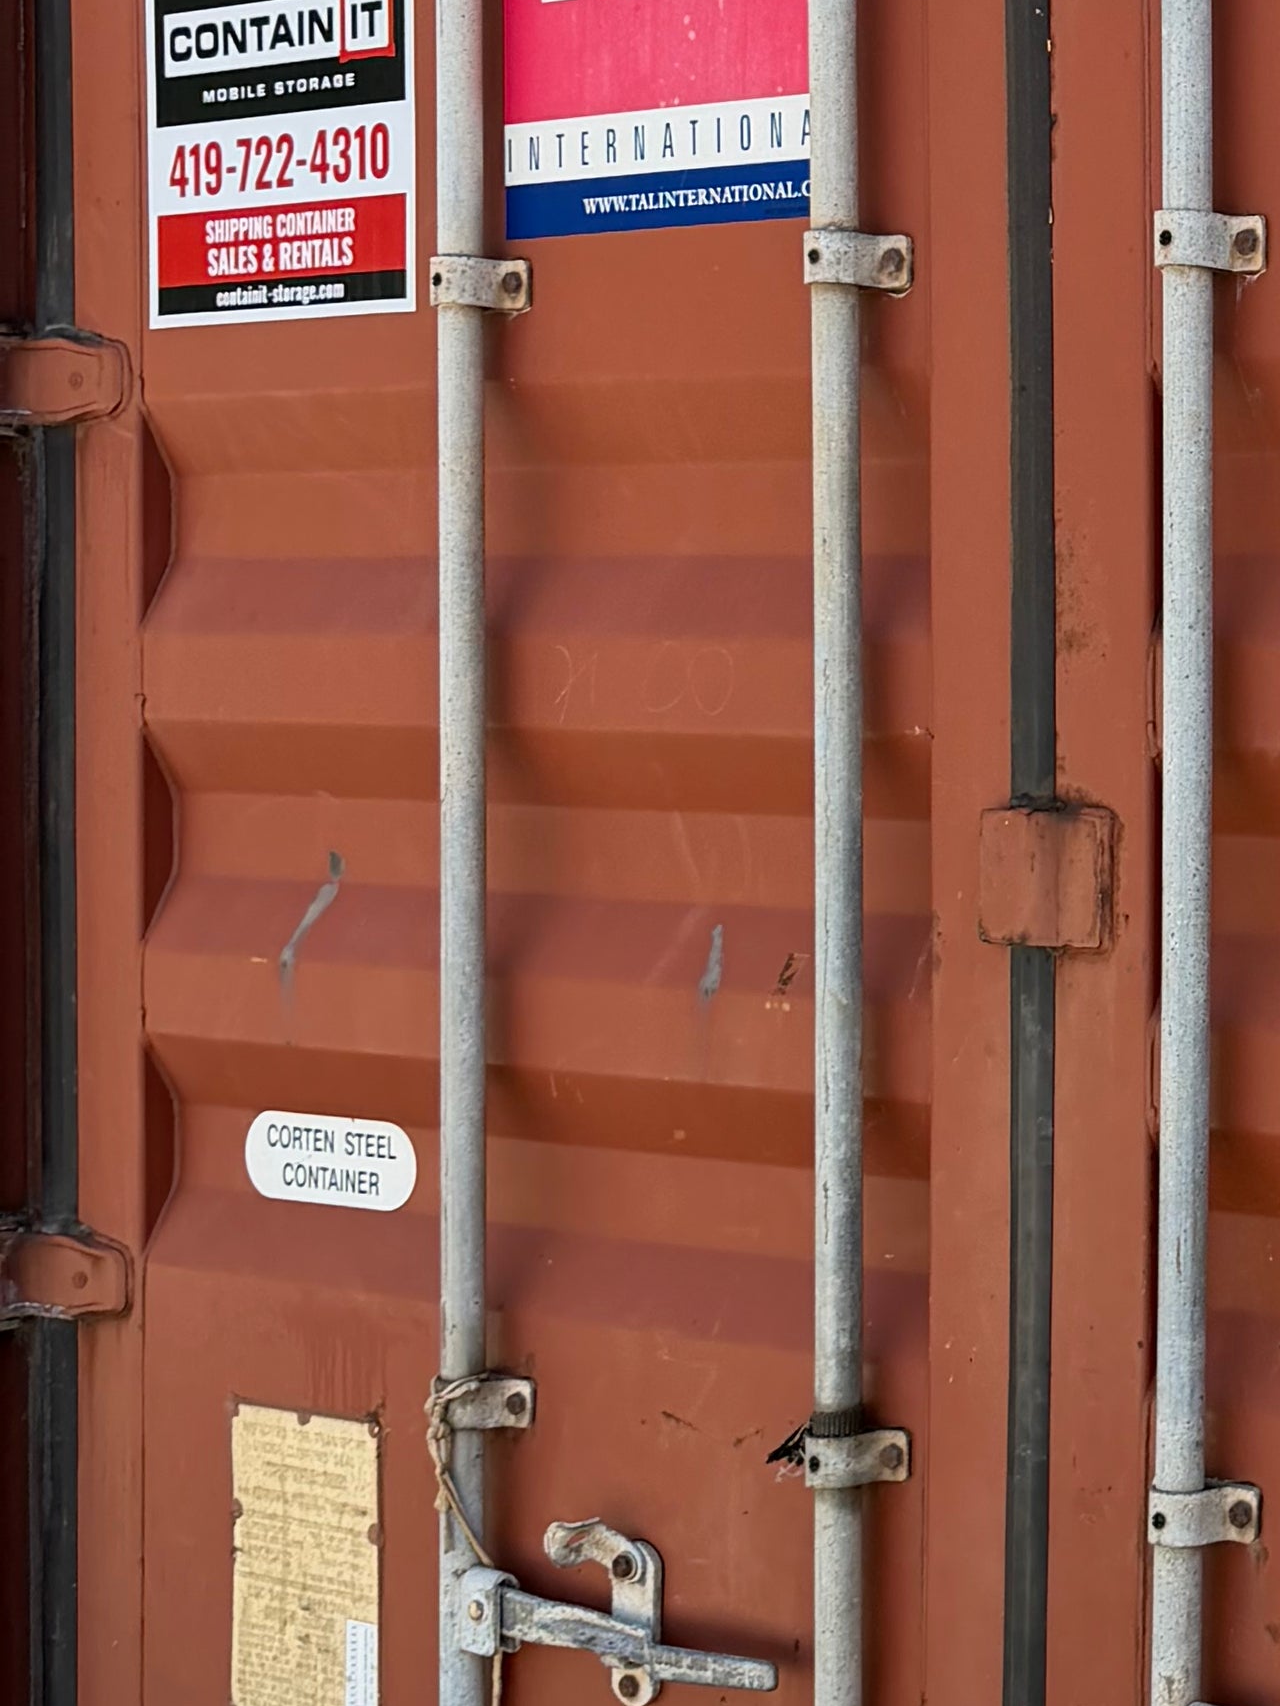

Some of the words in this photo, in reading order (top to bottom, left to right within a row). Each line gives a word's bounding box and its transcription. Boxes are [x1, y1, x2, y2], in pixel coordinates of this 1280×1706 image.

[203, 83, 266, 103] MOBILE
[274, 73, 355, 95] STORAGE
[170, 122, 390, 198] 419-722-4310
[205, 215, 273, 244] SHIPPING
[276, 207, 356, 237] CONTAINER
[208, 247, 258, 277] SALES
[262, 244, 275, 273] &
[279, 237, 354, 271] RENTALS
[216, 283, 345, 307] containit-storage.com
[267, 1124, 335, 1153] CORTEN
[345, 1132, 397, 1160] STEEL
[283, 1162, 380, 1196] CONTAINER
